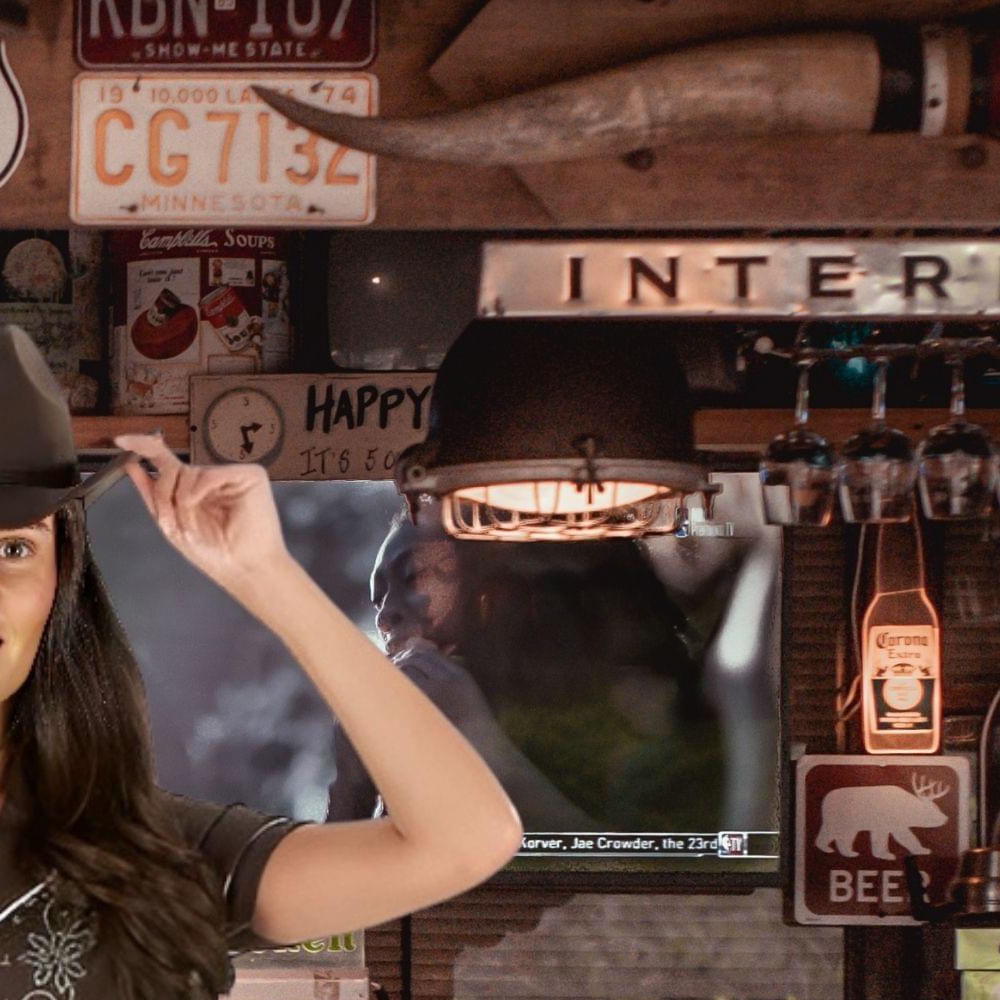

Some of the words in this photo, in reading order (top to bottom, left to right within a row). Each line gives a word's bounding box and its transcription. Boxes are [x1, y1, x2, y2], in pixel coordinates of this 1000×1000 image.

[245, 42, 306, 58] STATE
[141, 194, 302, 212] MINNESOTA
[567, 254, 951, 301] INTER
[305, 384, 432, 434] HAPPY
[300, 446, 350, 477] IT'S
[364, 447, 379, 472] 5
[875, 631, 929, 649] Corona
[887, 649, 921, 659] Extra
[570, 836, 594, 850] Jae
[662, 836, 685, 850] the
[688, 836, 719, 850] 23rd
